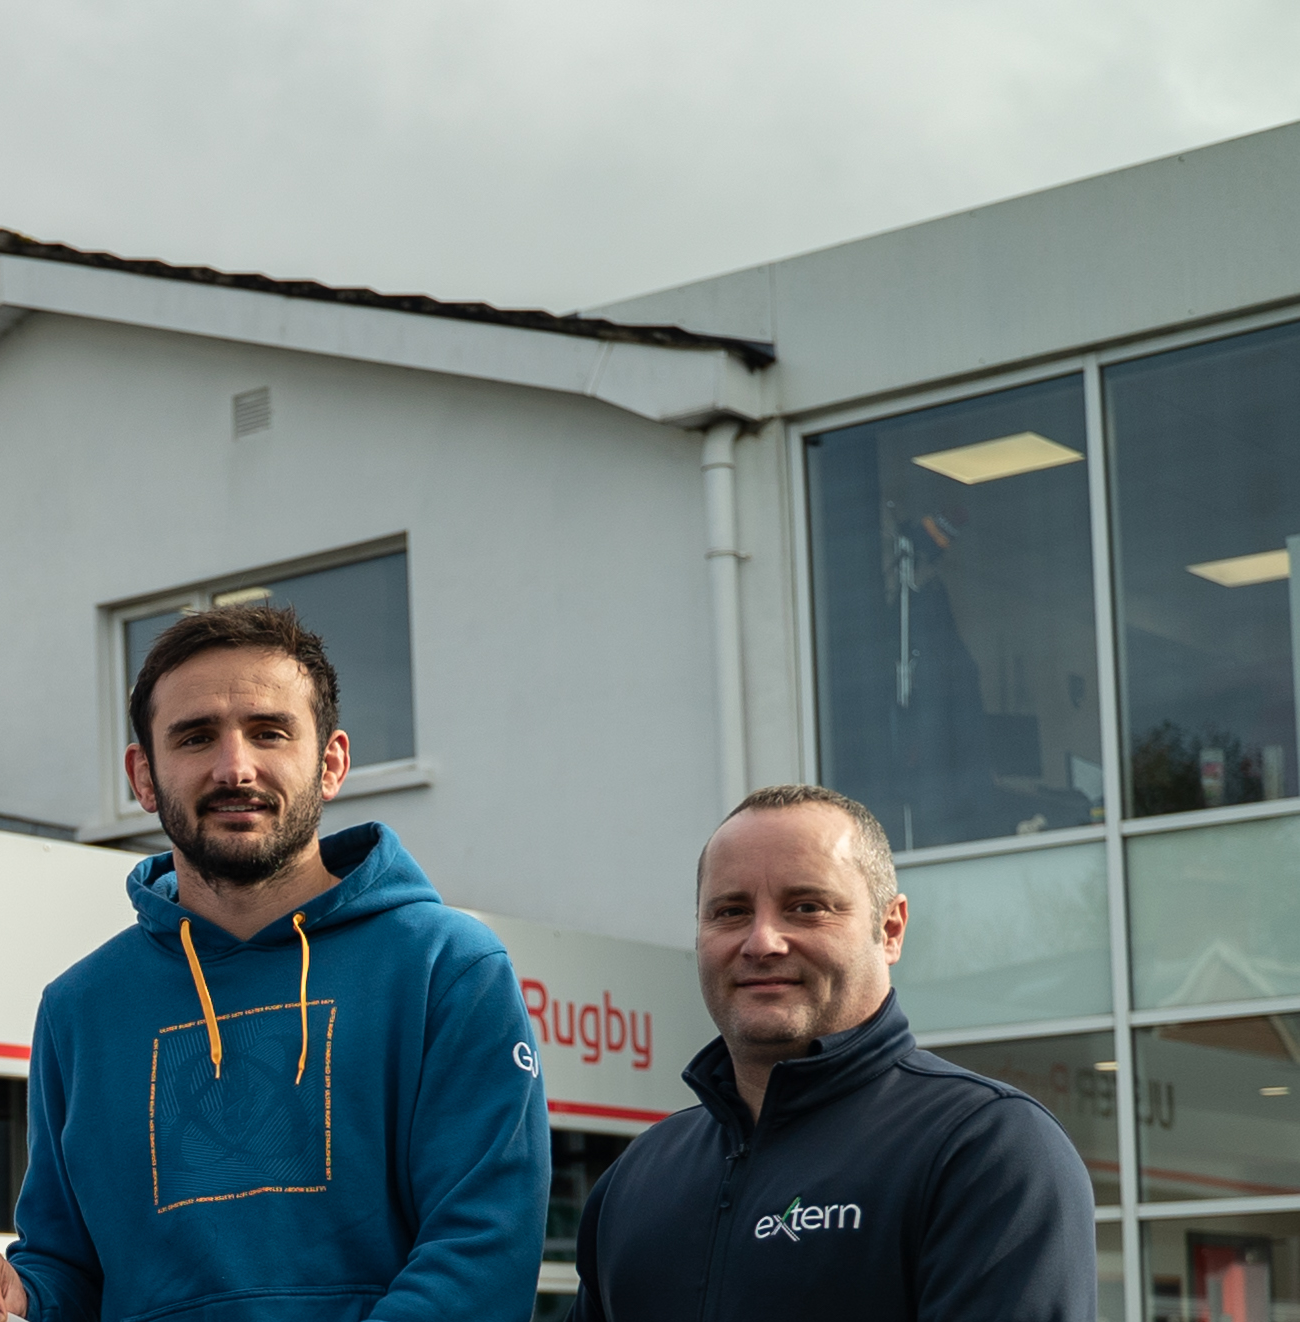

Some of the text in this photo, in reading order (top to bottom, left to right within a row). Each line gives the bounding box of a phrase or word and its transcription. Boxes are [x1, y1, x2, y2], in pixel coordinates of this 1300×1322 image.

[520, 977, 653, 1070] Rugby
[512, 1041, 539, 1078] GJ
[754, 1196, 862, 1242] extern
